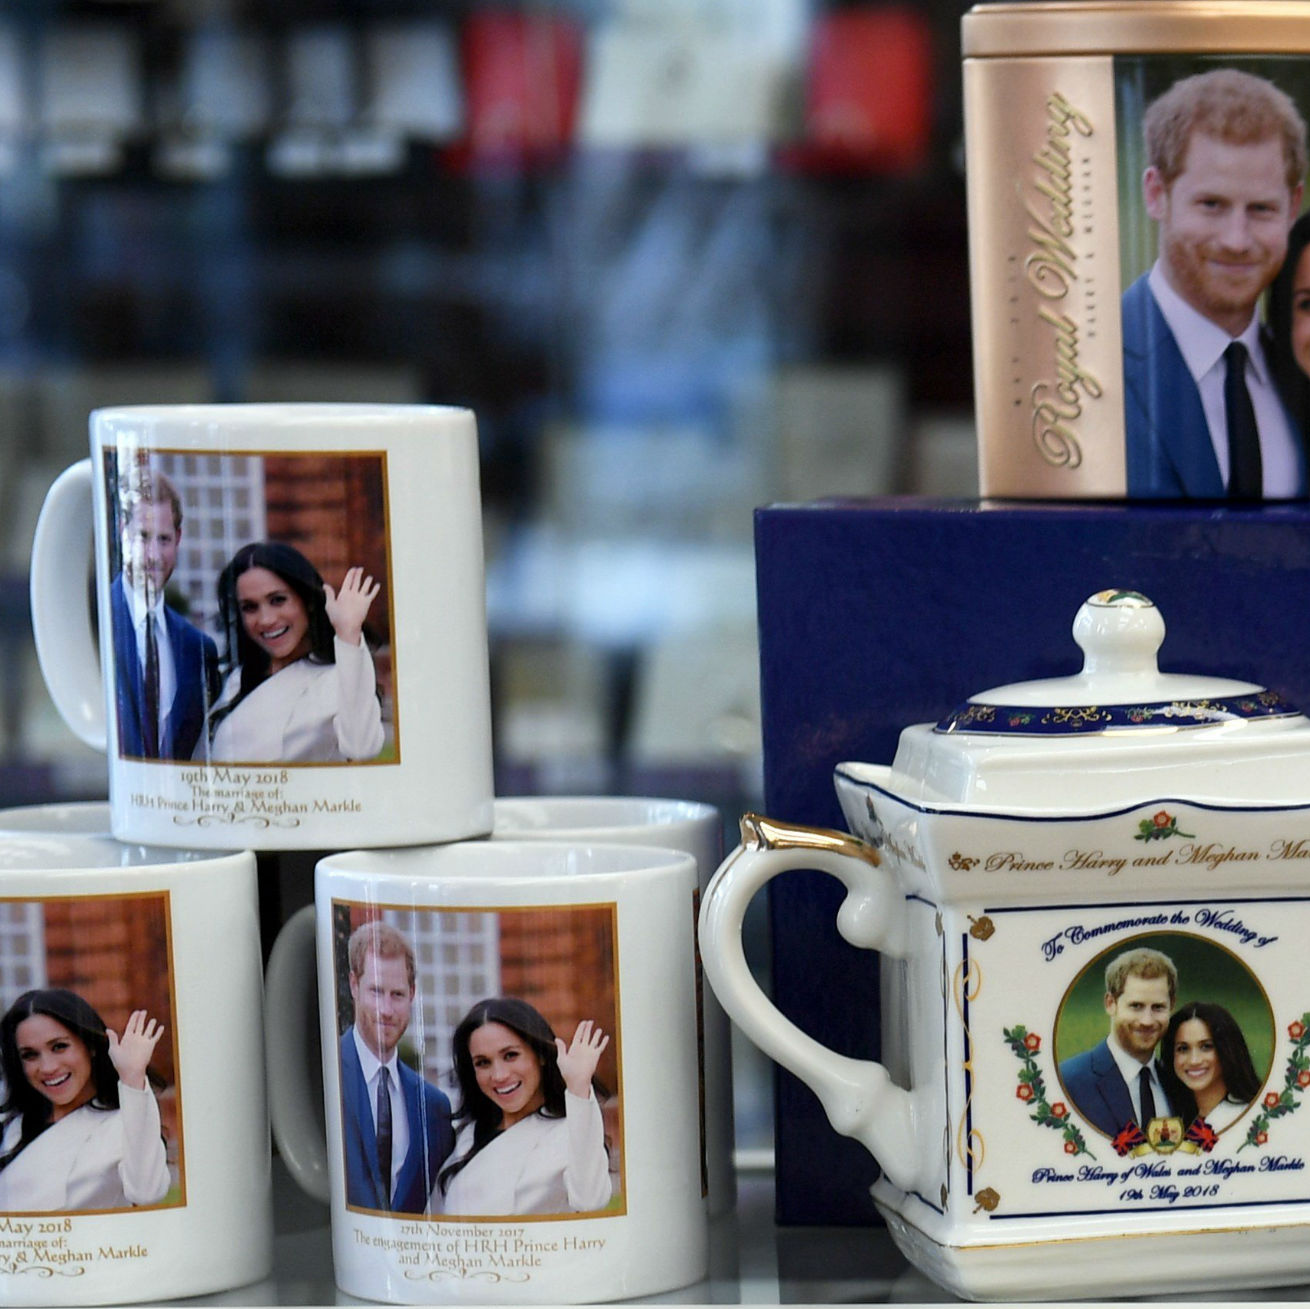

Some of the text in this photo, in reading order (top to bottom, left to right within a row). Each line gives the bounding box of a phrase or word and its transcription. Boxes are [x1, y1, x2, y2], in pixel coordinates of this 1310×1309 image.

[1024, 91, 1102, 469] Royal Wedding
[180, 769, 289, 790] 19th May 2018
[192, 800, 230, 815] Harry
[233, 801, 246, 813] &
[250, 800, 308, 816] Meghan
[312, 800, 362, 813] Markle
[984, 853, 1054, 873] Prince
[1058, 851, 1127, 876] Harry
[1132, 849, 1170, 867] and
[1174, 842, 1260, 868] Meghan
[1041, 931, 1064, 962] To
[1064, 913, 1169, 945] Commemorate
[1169, 910, 1190, 924] the
[1194, 908, 1258, 944] Wedding
[1119, 1184, 1220, 1203] 19th May 2018
[38, 1218, 72, 1233] 2018
[426, 1223, 494, 1238] November
[498, 1227, 525, 1239] 2017
[353, 1228, 371, 1246] The
[446, 1238, 461, 1254] of
[464, 1239, 509, 1253] HRH
[514, 1238, 559, 1252] Prince
[563, 1235, 607, 1251] Harry
[15, 1251, 28, 1264] &
[33, 1249, 93, 1265] Meghan
[97, 1244, 149, 1260] Markle
